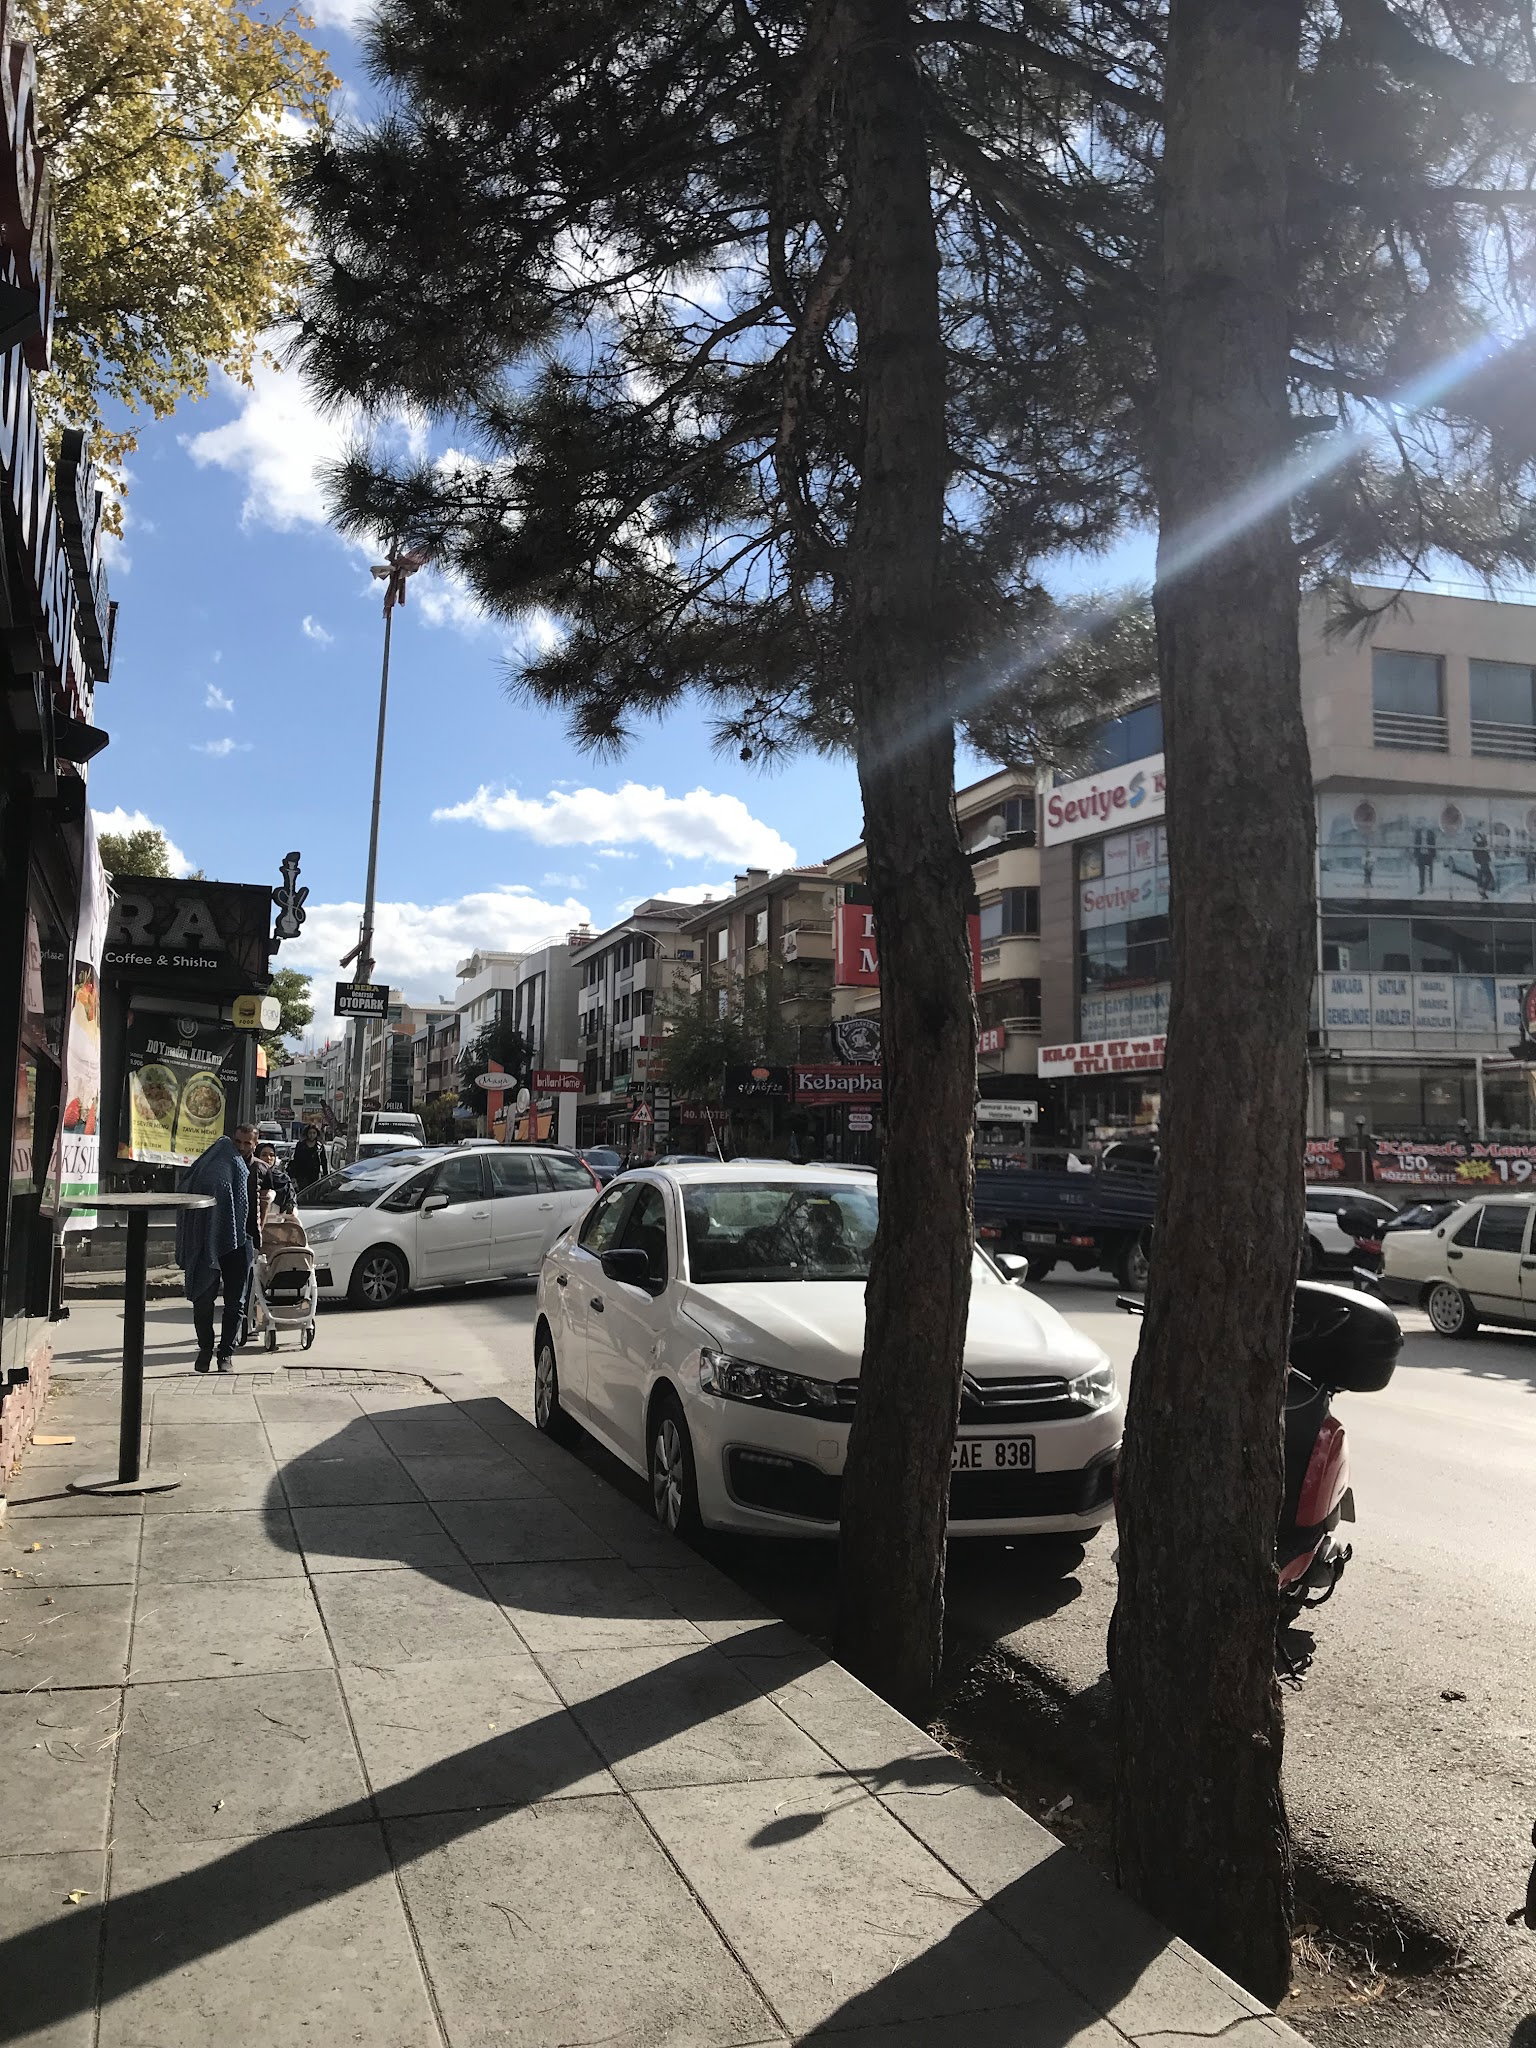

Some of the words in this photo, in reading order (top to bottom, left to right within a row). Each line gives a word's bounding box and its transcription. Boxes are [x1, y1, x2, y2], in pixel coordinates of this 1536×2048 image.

[1047, 786, 1127, 828] Seviye
[1083, 886, 1140, 912] Seviye
[105, 951, 152, 966] Coffee
[157, 954, 168, 966] &
[173, 955, 218, 968] Shisha
[339, 997, 385, 1010] OTOPARK
[1042, 1047, 1076, 1062] KİLO
[1108, 1041, 1129, 1056] ET
[1153, 1038, 1165, 1051] K
[798, 1073, 883, 1094] Kebapha
[1398, 1155, 1429, 1172] 150
[995, 1442, 1031, 1468] 838
